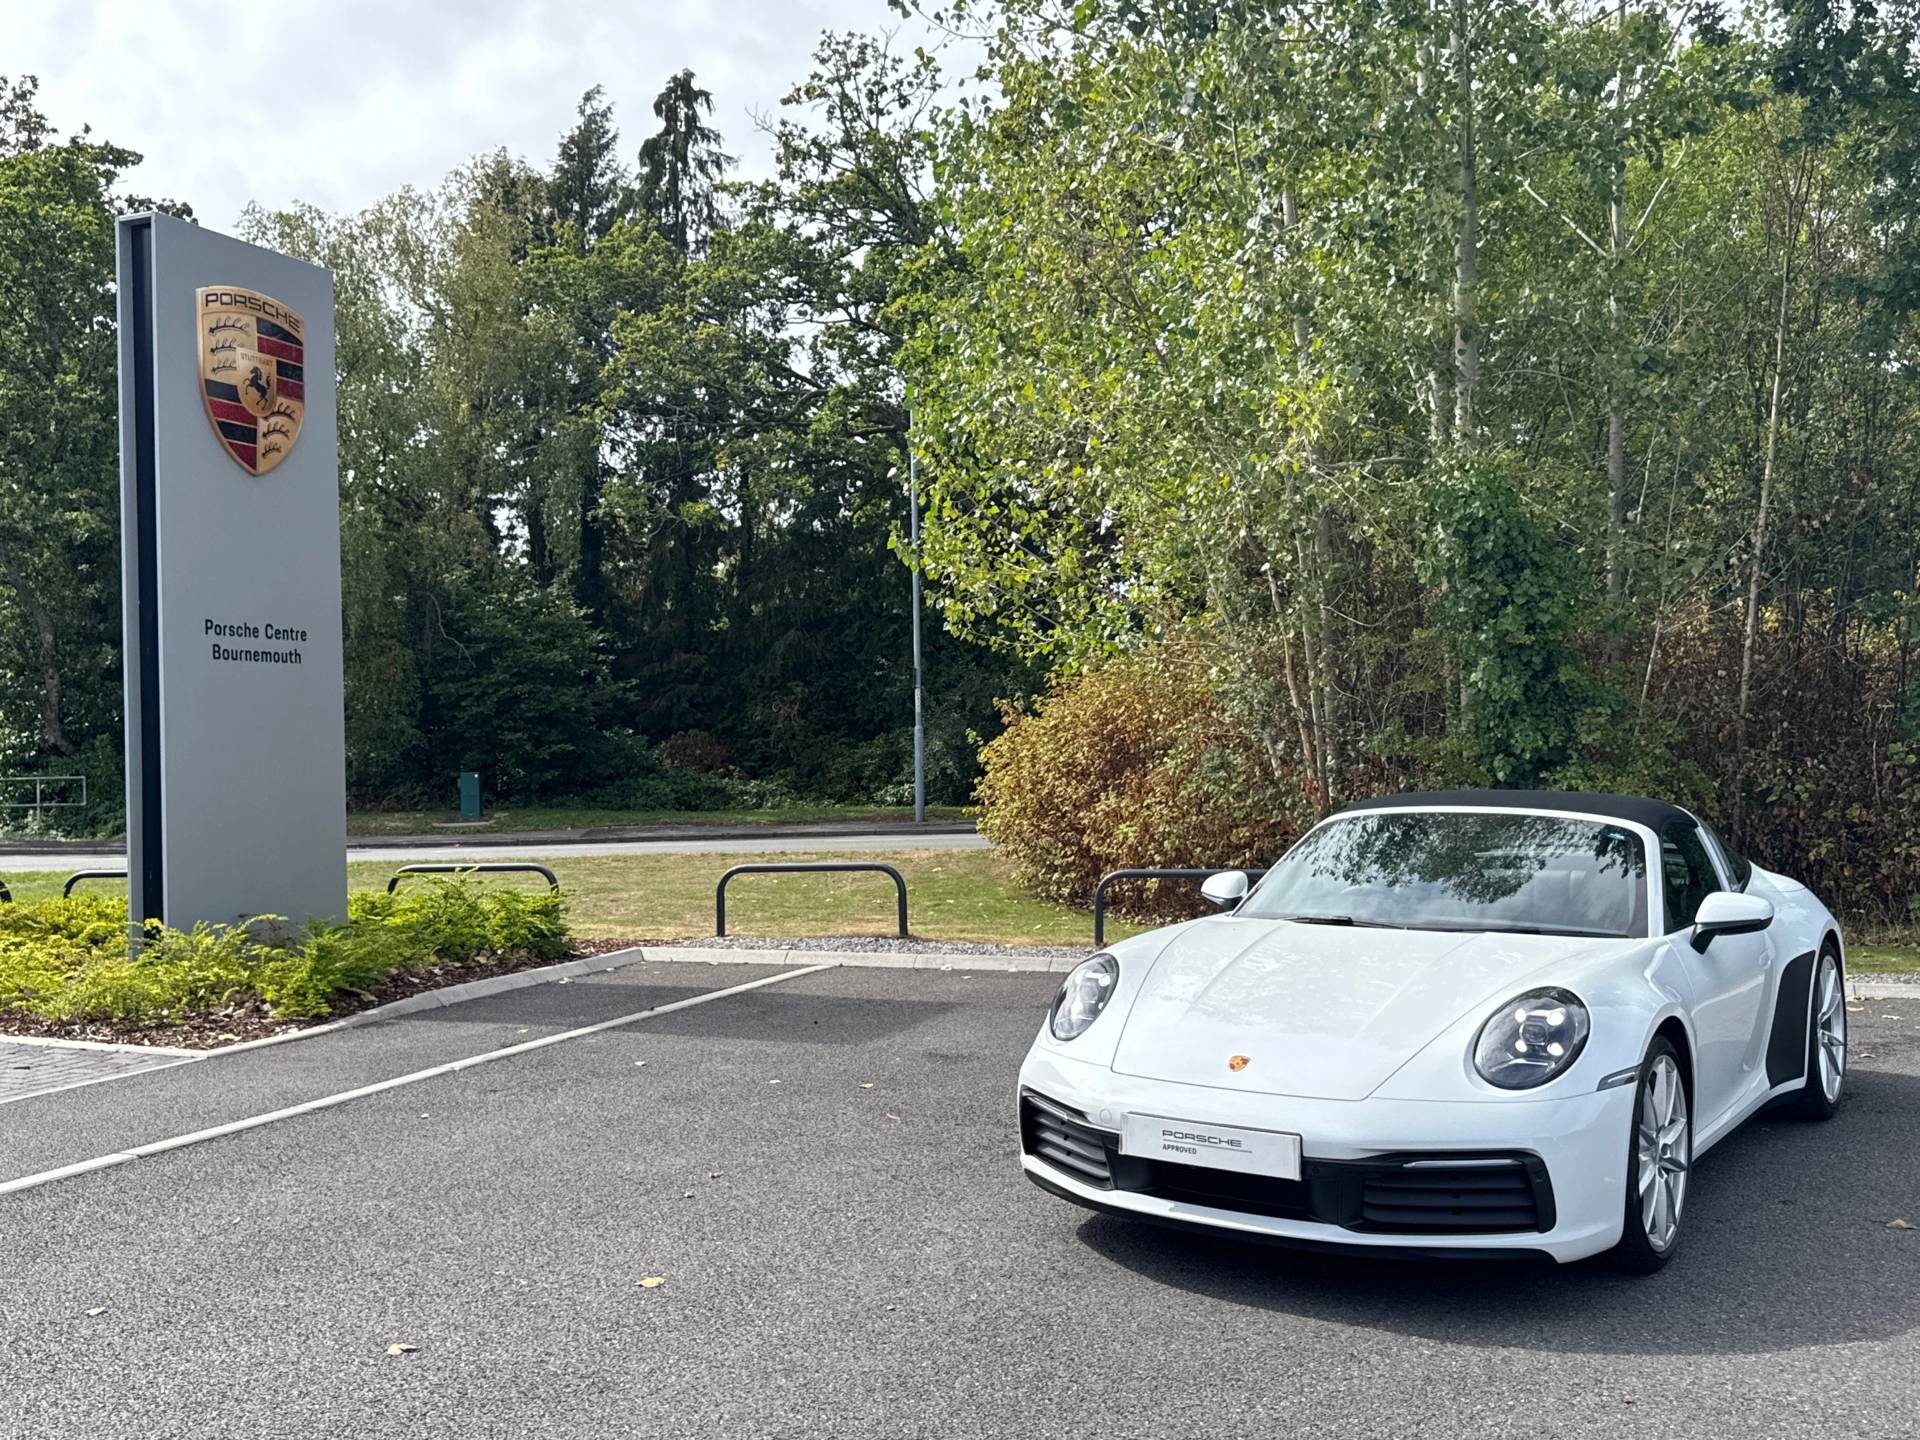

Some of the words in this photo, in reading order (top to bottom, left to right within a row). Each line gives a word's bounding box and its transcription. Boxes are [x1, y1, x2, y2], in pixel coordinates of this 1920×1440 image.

[205, 292, 301, 333] PORSCHE
[204, 618, 260, 639] Porsche
[264, 623, 308, 642] Centre
[212, 643, 302, 664] Bournemouth
[1162, 1129, 1242, 1148] PORSCHE
[1162, 1143, 1197, 1155] APPROVED
